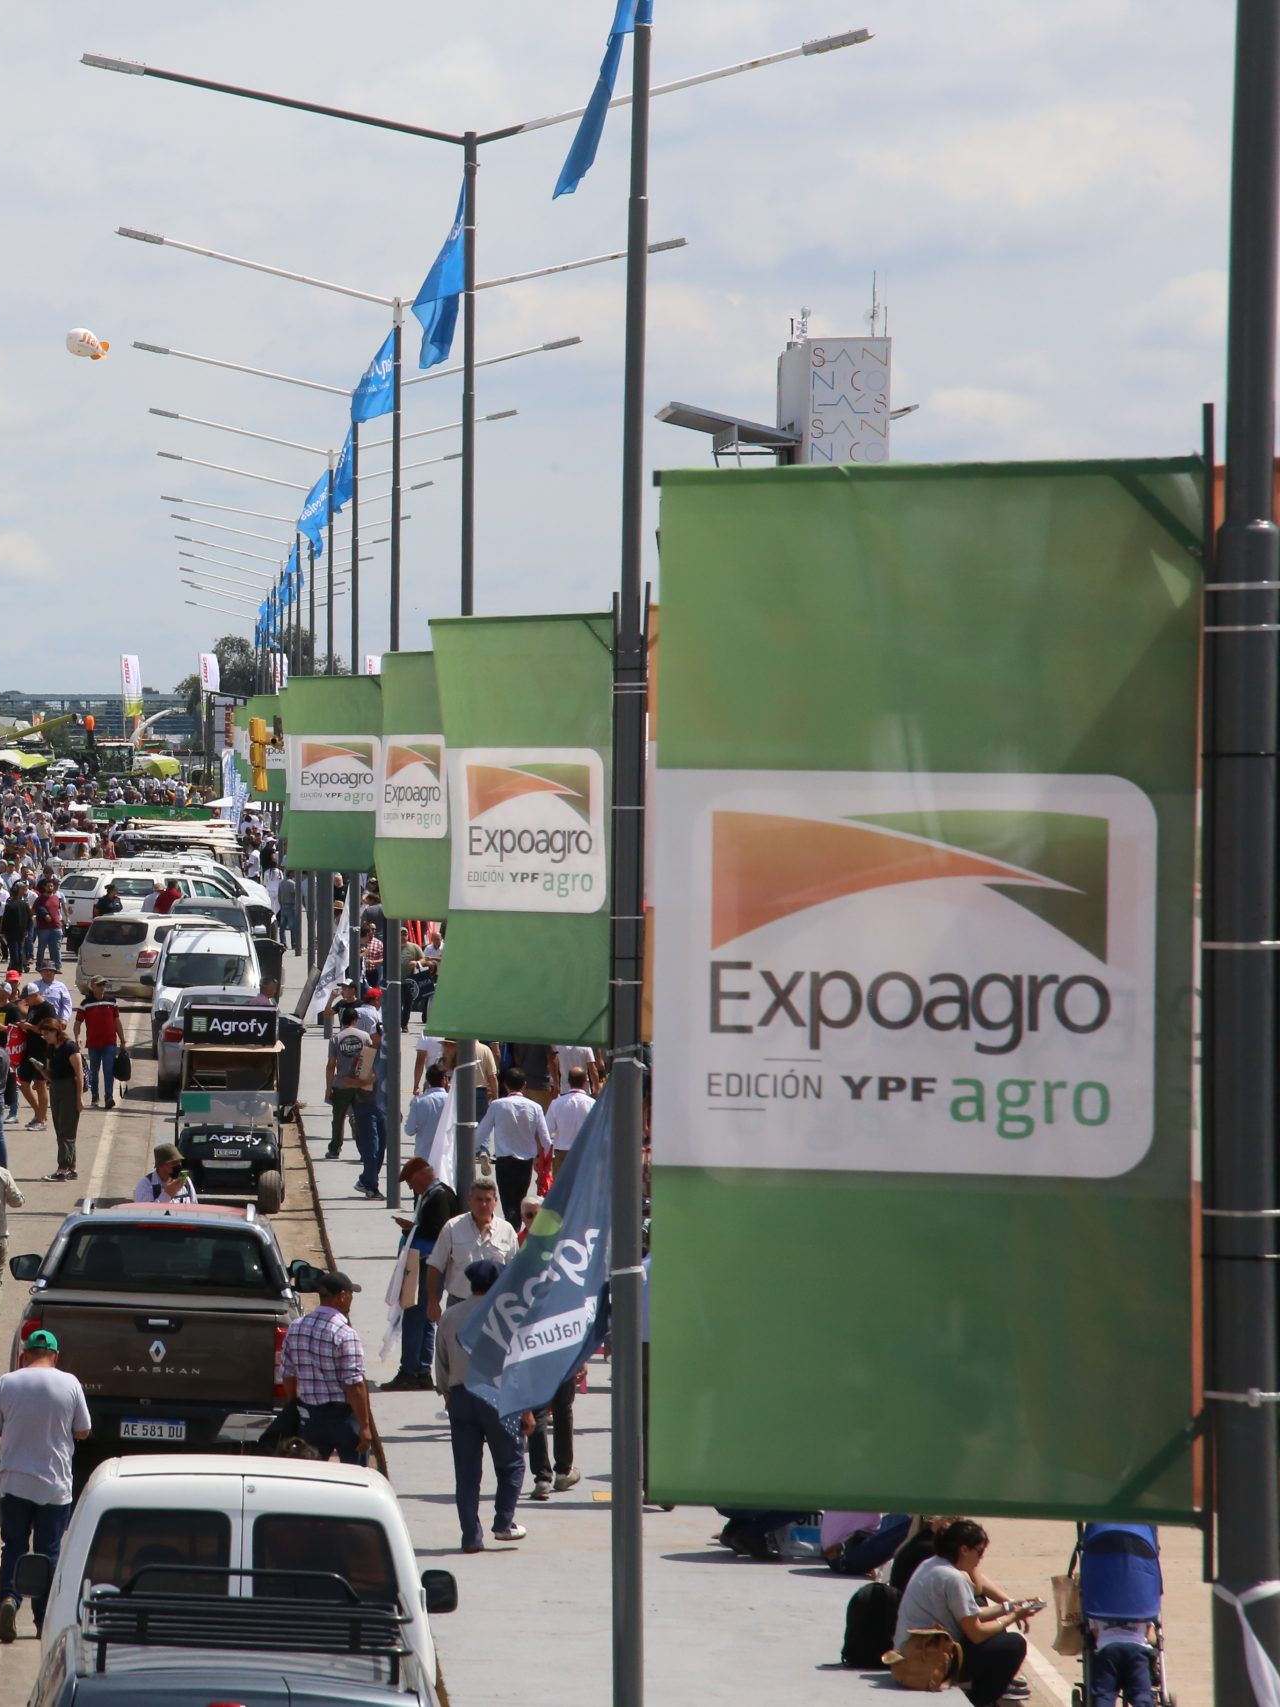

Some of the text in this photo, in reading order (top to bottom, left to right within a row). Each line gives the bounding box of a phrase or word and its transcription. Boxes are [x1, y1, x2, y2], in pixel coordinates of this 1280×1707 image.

[300, 770, 375, 789] Expoagro
[344, 790, 374, 803] agro
[384, 784, 441, 806] Expoagro
[400, 812, 416, 820] YPF
[416, 811, 442, 829] agro
[467, 825, 593, 864] Expoagro
[467, 868, 594, 898] EDICIÓN YPF agro
[708, 960, 1112, 1056] Expoagro
[209, 1018, 268, 1037] Agrofy
[707, 1069, 1111, 1140] EDICIÓN YPF agro
[209, 1134, 262, 1145] Agrofy
[112, 1365, 201, 1375] ALASKAN
[123, 1423, 183, 1438] AE 581 DU
